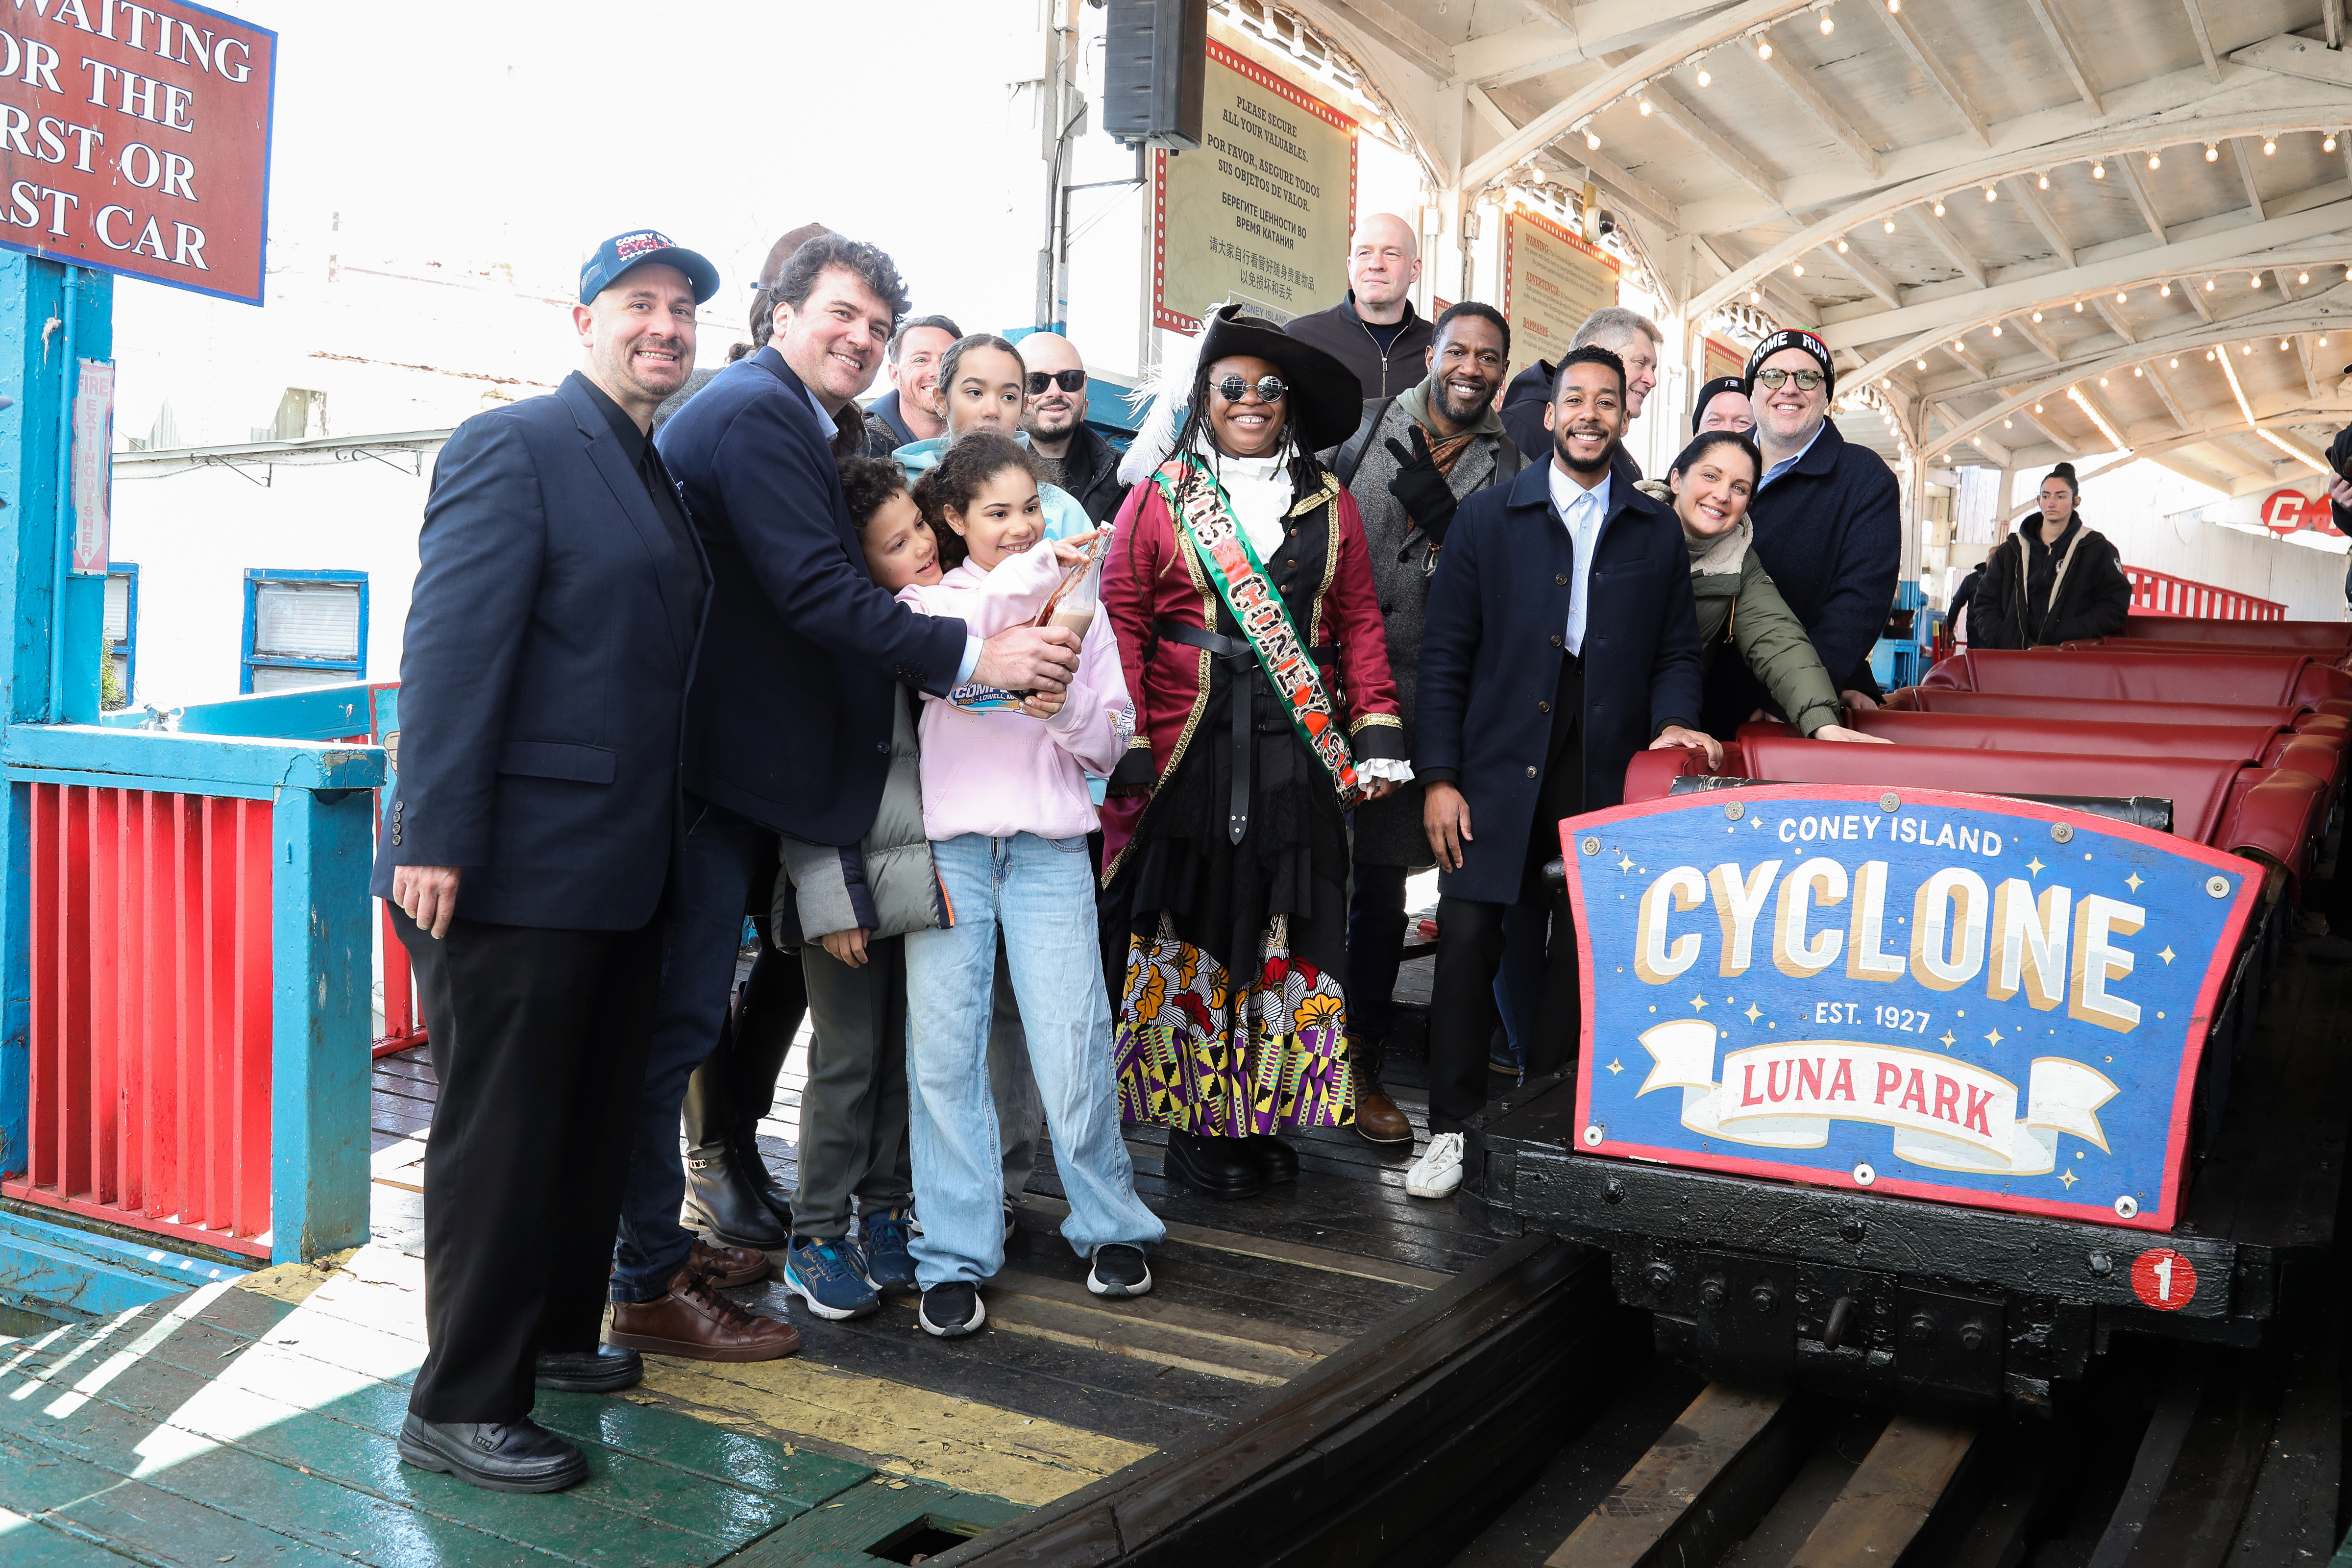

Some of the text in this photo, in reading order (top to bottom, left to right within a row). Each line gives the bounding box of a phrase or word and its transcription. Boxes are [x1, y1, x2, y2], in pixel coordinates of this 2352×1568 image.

[0, 28, 194, 133] OR THE
[1223, 109, 1308, 163] ALL YOUR VALUABLES.
[1237, 96, 1297, 138] PLEASE SECURE
[0, 102, 198, 202] RST OR
[1207, 133, 1320, 198] POR FAVOR, ASEGURE TODOS
[1219, 159, 1310, 212] SUS OBJETOS DE VALOR.
[0, 180, 209, 270] ST CAR
[1222, 191, 1307, 239] БЕРЕГИТЕ ЦЕННОСТИ ВО
[1236, 215, 1294, 250] ВРЕМЯ КАТАНИЯ
[615, 233, 654, 246] CONEY
[1525, 233, 1550, 255] WARNING:
[1525, 271, 1561, 295] ADVERTENCIA:
[1241, 301, 1264, 317] CONEY
[1266, 310, 1287, 324] ISLAND
[1752, 331, 1827, 367] HOME RUN
[79, 374, 109, 397] FIRE
[81, 398, 97, 557] EXTINGUISHER
[1226, 572, 1333, 724] CONEY
[1779, 815, 2003, 857] CONEY ISLAND
[1634, 856, 2146, 1034] CYCLONE
[1815, 1002, 1931, 1034] EST. 1927
[1740, 1057, 1995, 1138] LUNA PARK
[2154, 1257, 2173, 1301] 1
